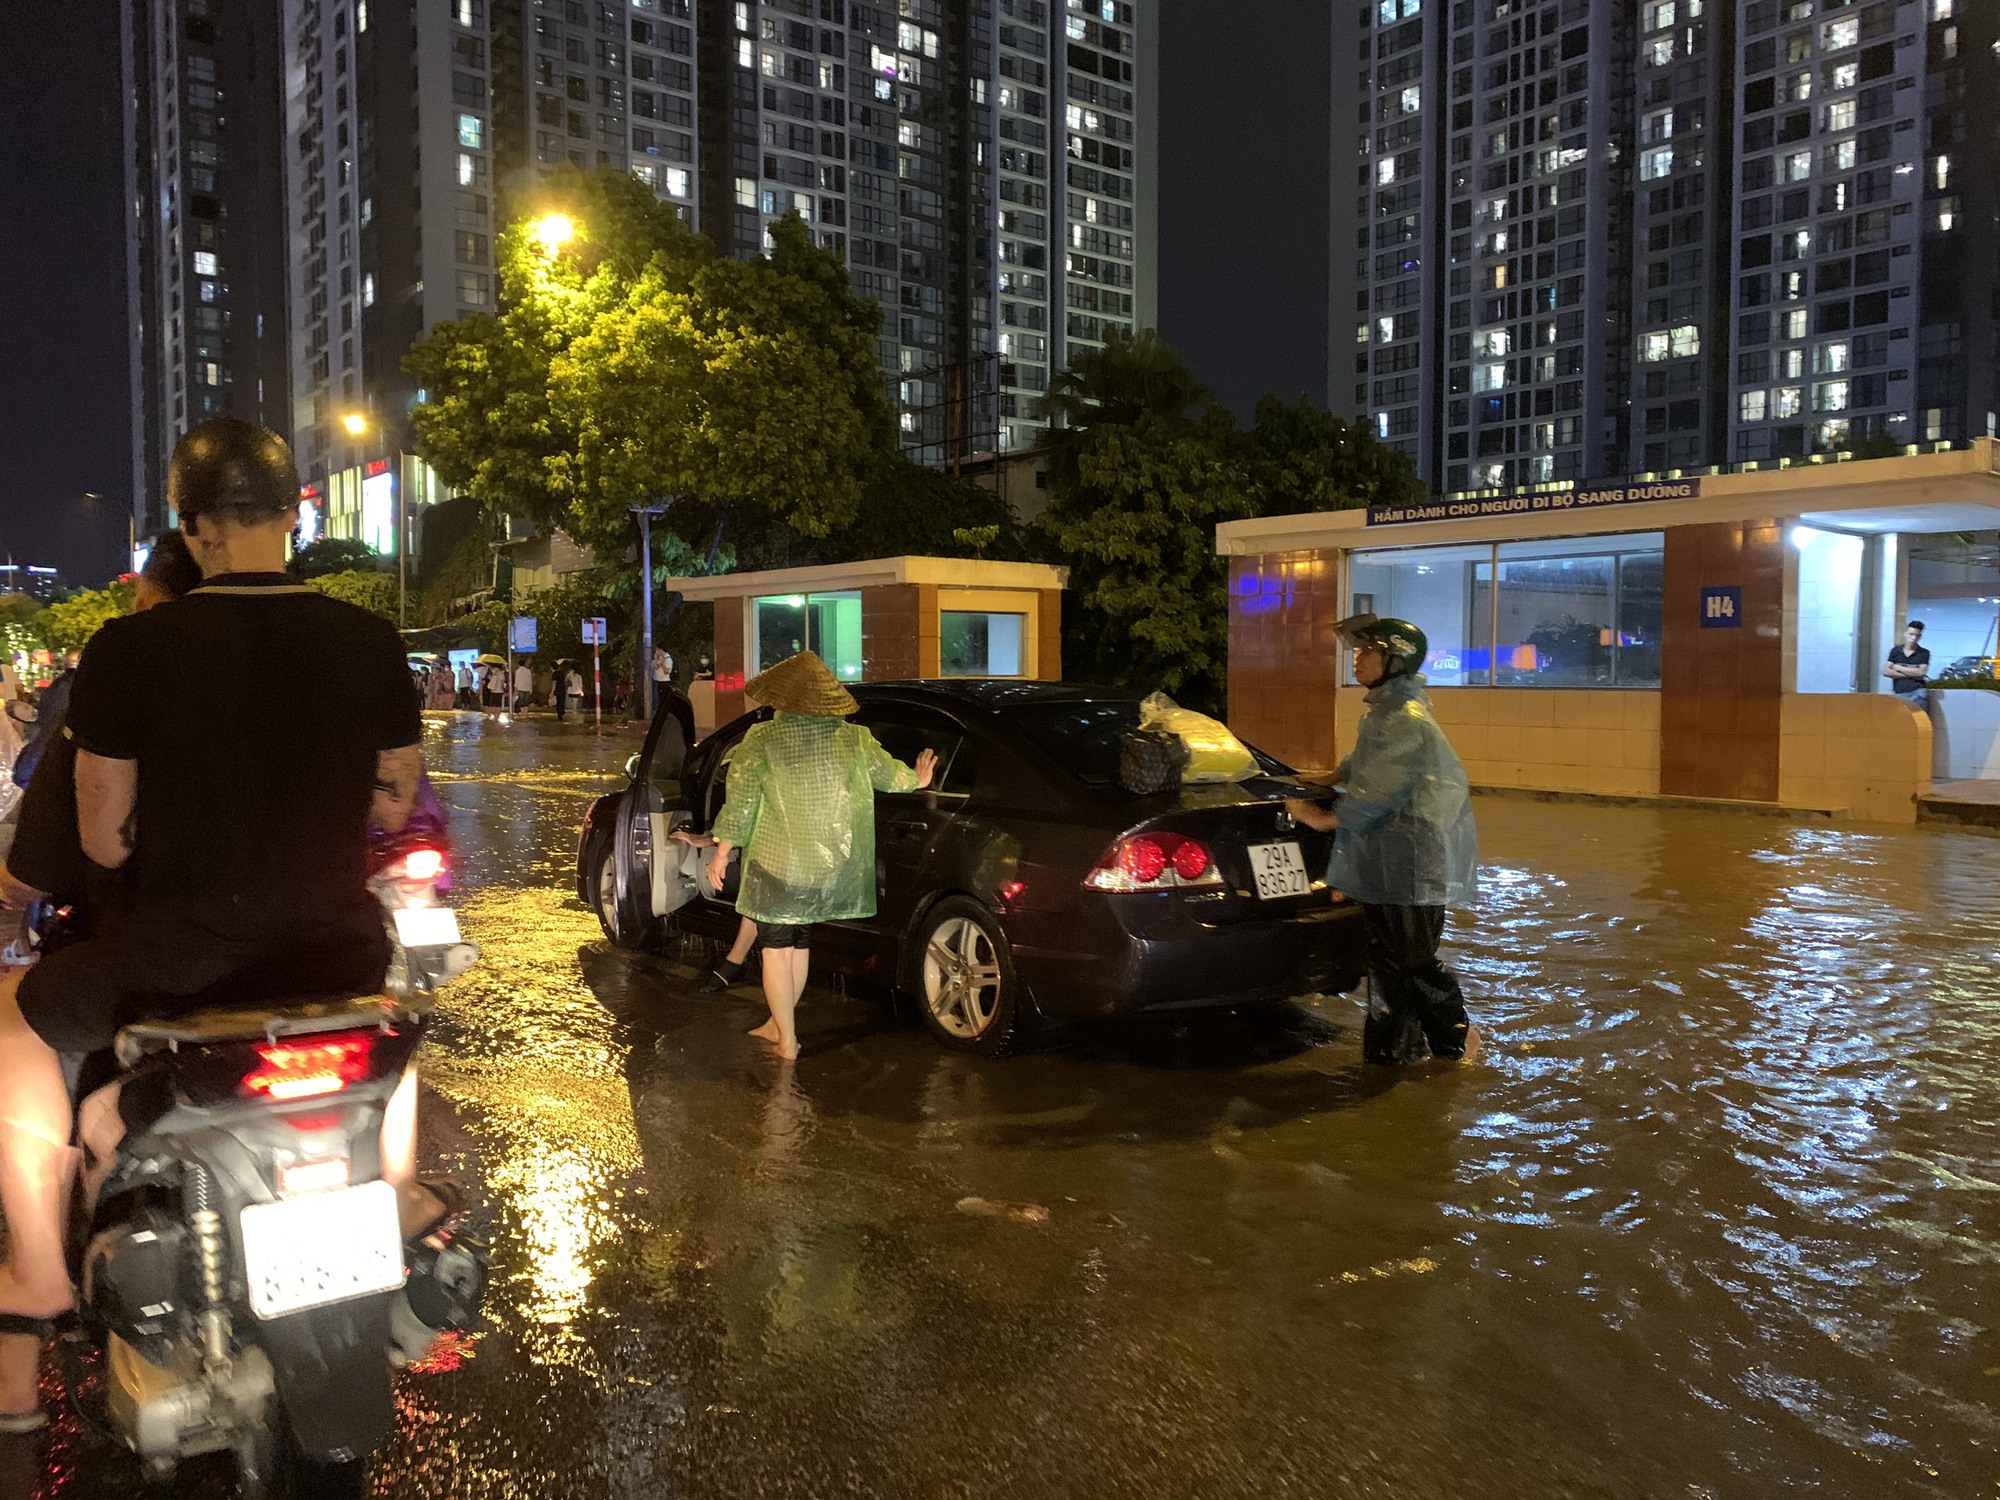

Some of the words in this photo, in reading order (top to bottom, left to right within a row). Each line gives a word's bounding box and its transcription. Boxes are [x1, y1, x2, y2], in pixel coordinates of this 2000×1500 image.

[1374, 507, 1404, 523] HẦM
[1406, 506, 1446, 520] DÀNH
[1449, 503, 1479, 516] CHO
[1481, 496, 1529, 513] NGƯỜI
[1532, 496, 1549, 509] ĐI
[1552, 493, 1574, 508] BỘ
[1578, 489, 1624, 504] SANG
[1627, 483, 1691, 500] ĐƯỜNG
[1706, 596, 1735, 618] H4
[1262, 845, 1293, 869] 29A
